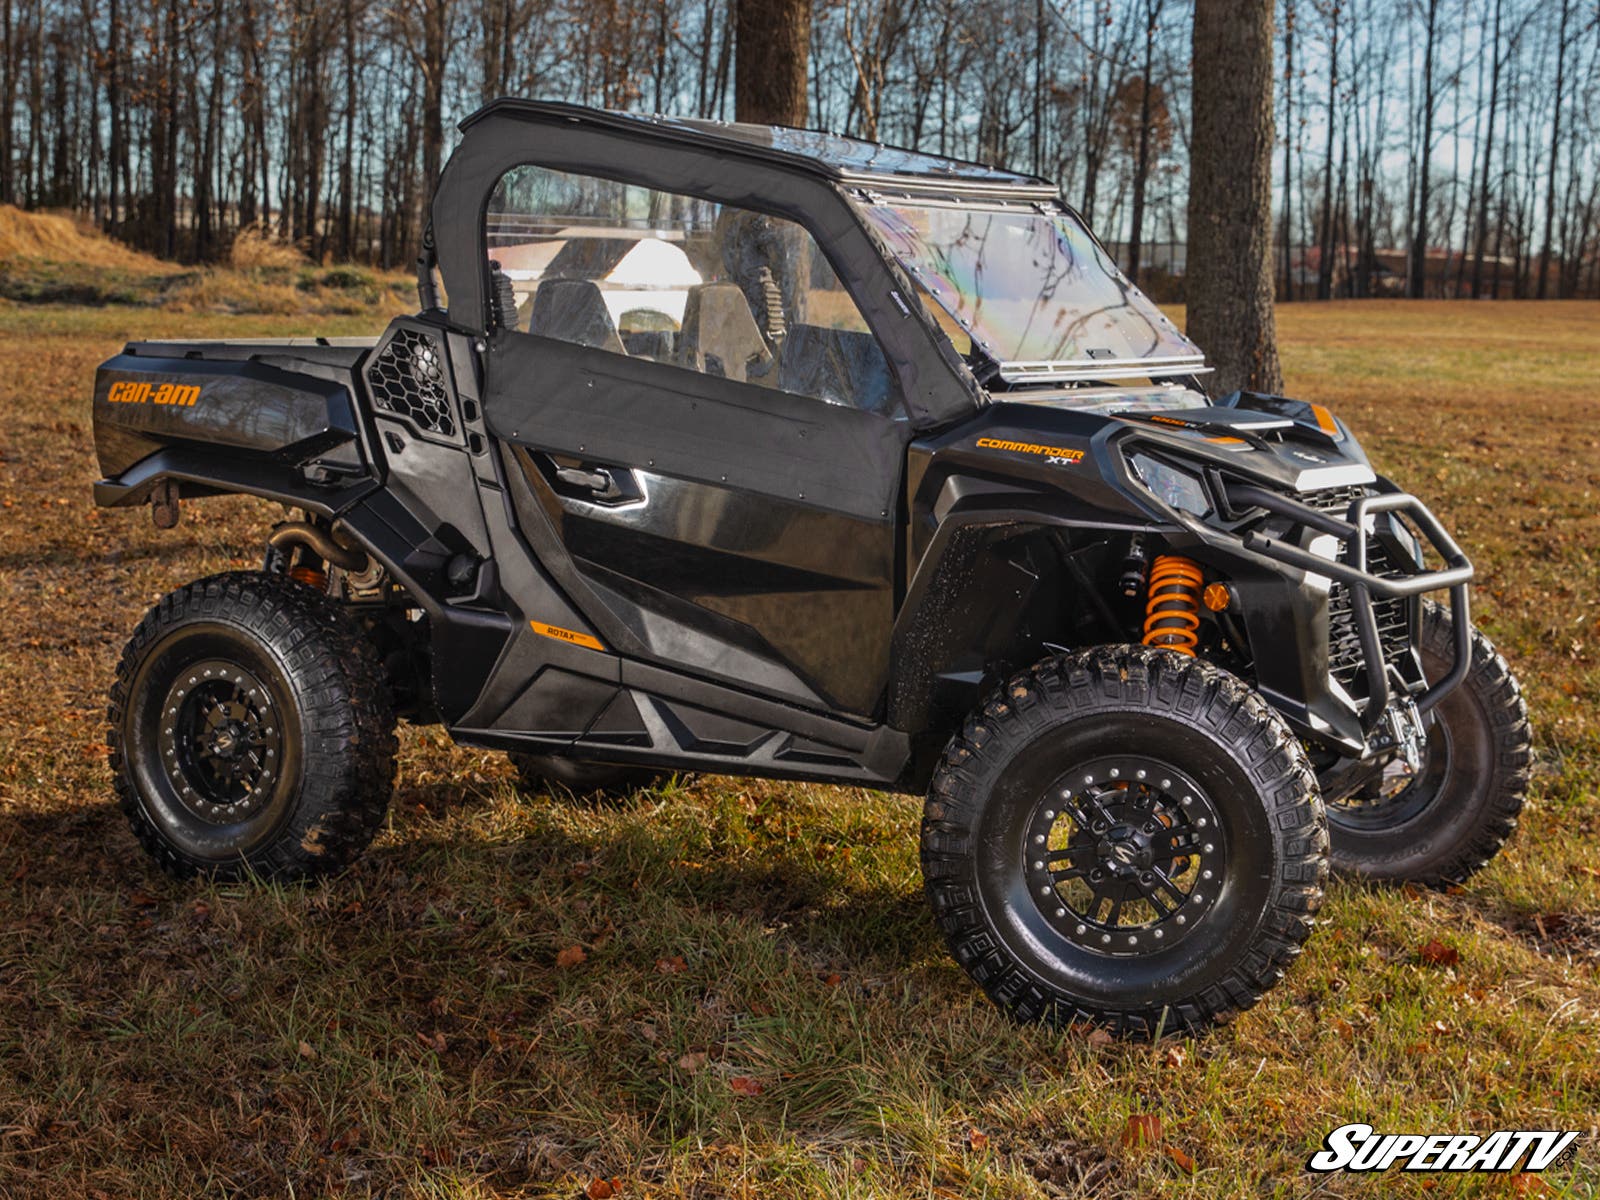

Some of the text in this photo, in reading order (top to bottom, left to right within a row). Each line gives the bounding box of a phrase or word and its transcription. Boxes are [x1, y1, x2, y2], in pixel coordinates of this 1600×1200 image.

[107, 381, 201, 406] can-am
[976, 437, 1085, 459] COMMANDER
[547, 627, 575, 641] ROTAX
